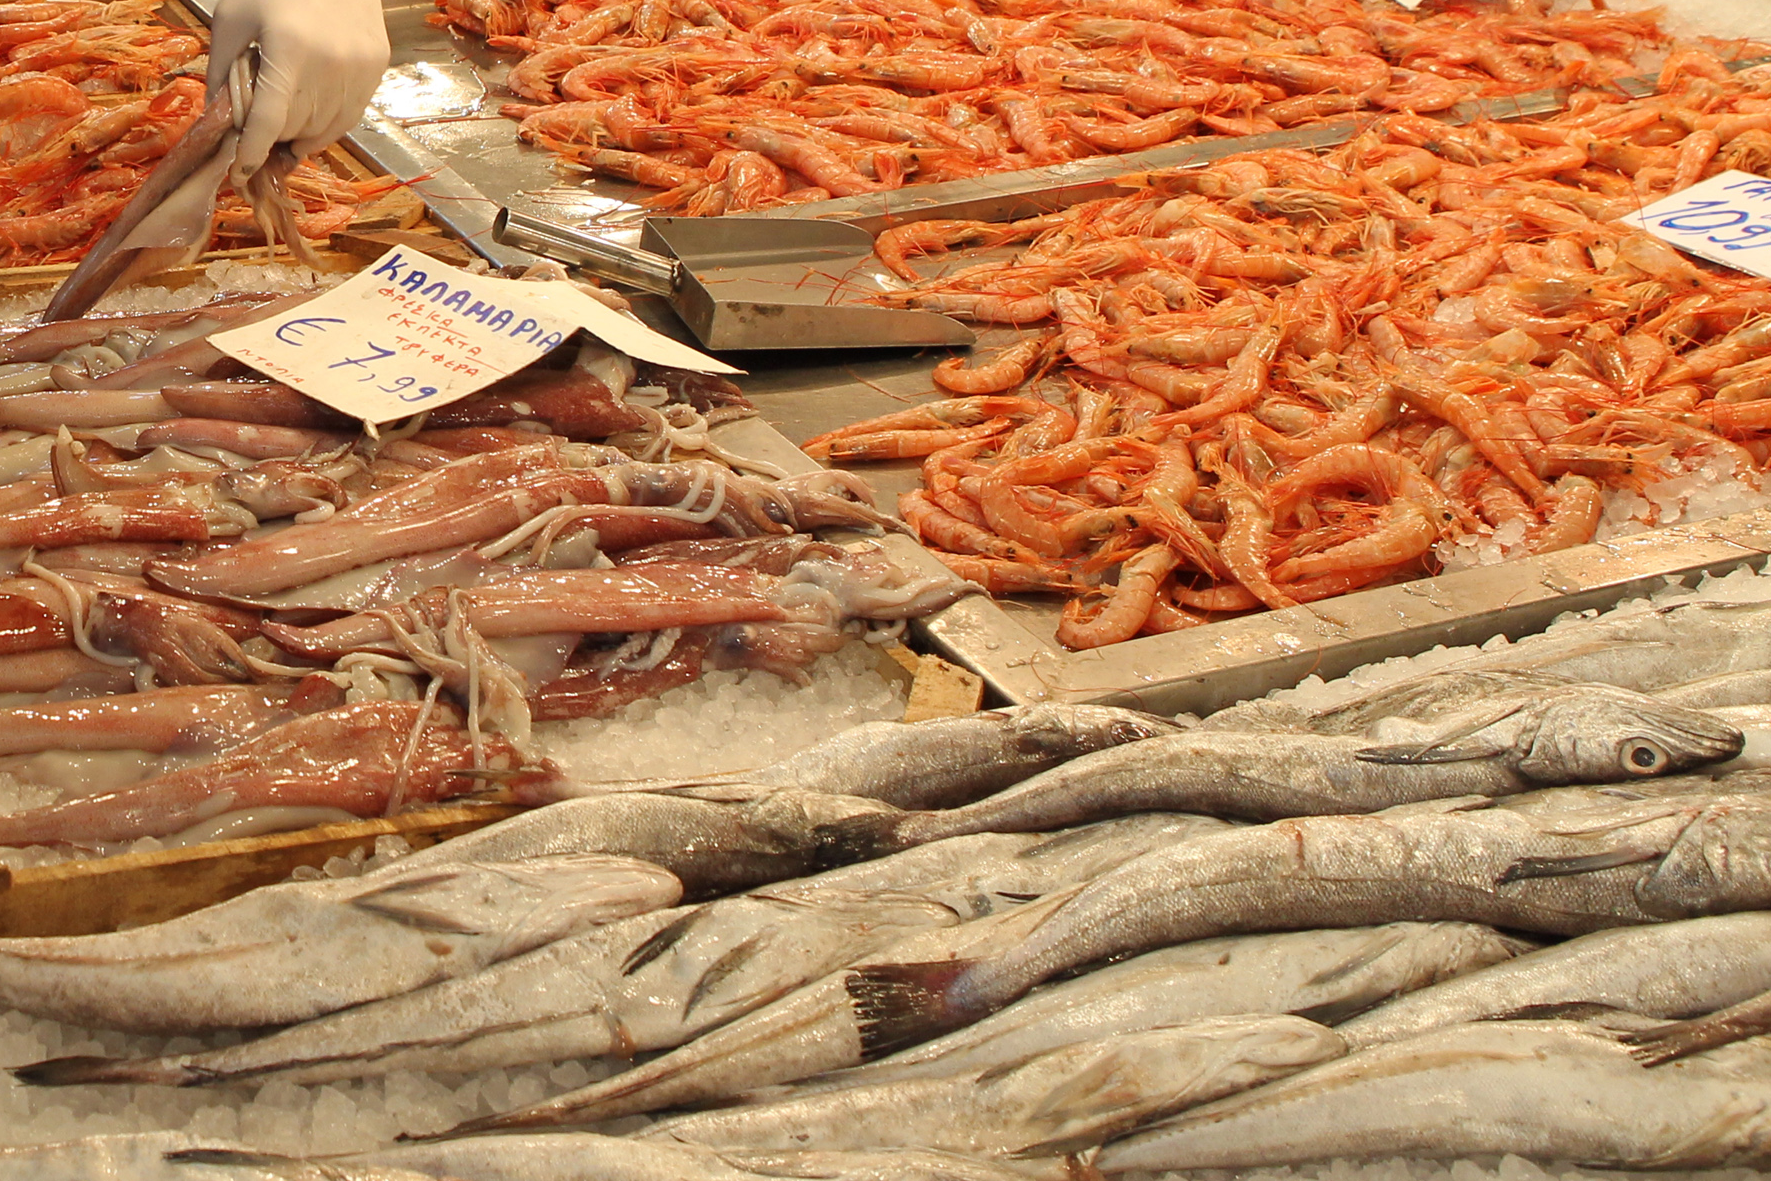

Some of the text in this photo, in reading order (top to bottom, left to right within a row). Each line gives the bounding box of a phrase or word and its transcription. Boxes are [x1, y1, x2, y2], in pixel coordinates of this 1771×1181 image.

[371, 253, 563, 354] ΚΑΛΑΜΑΡΙΑ
[377, 286, 454, 328] ΦΡΕΣΚΑ
[236, 347, 306, 385] ΝΤΟΠΙΑ
[275, 316, 438, 403] € 7,99
